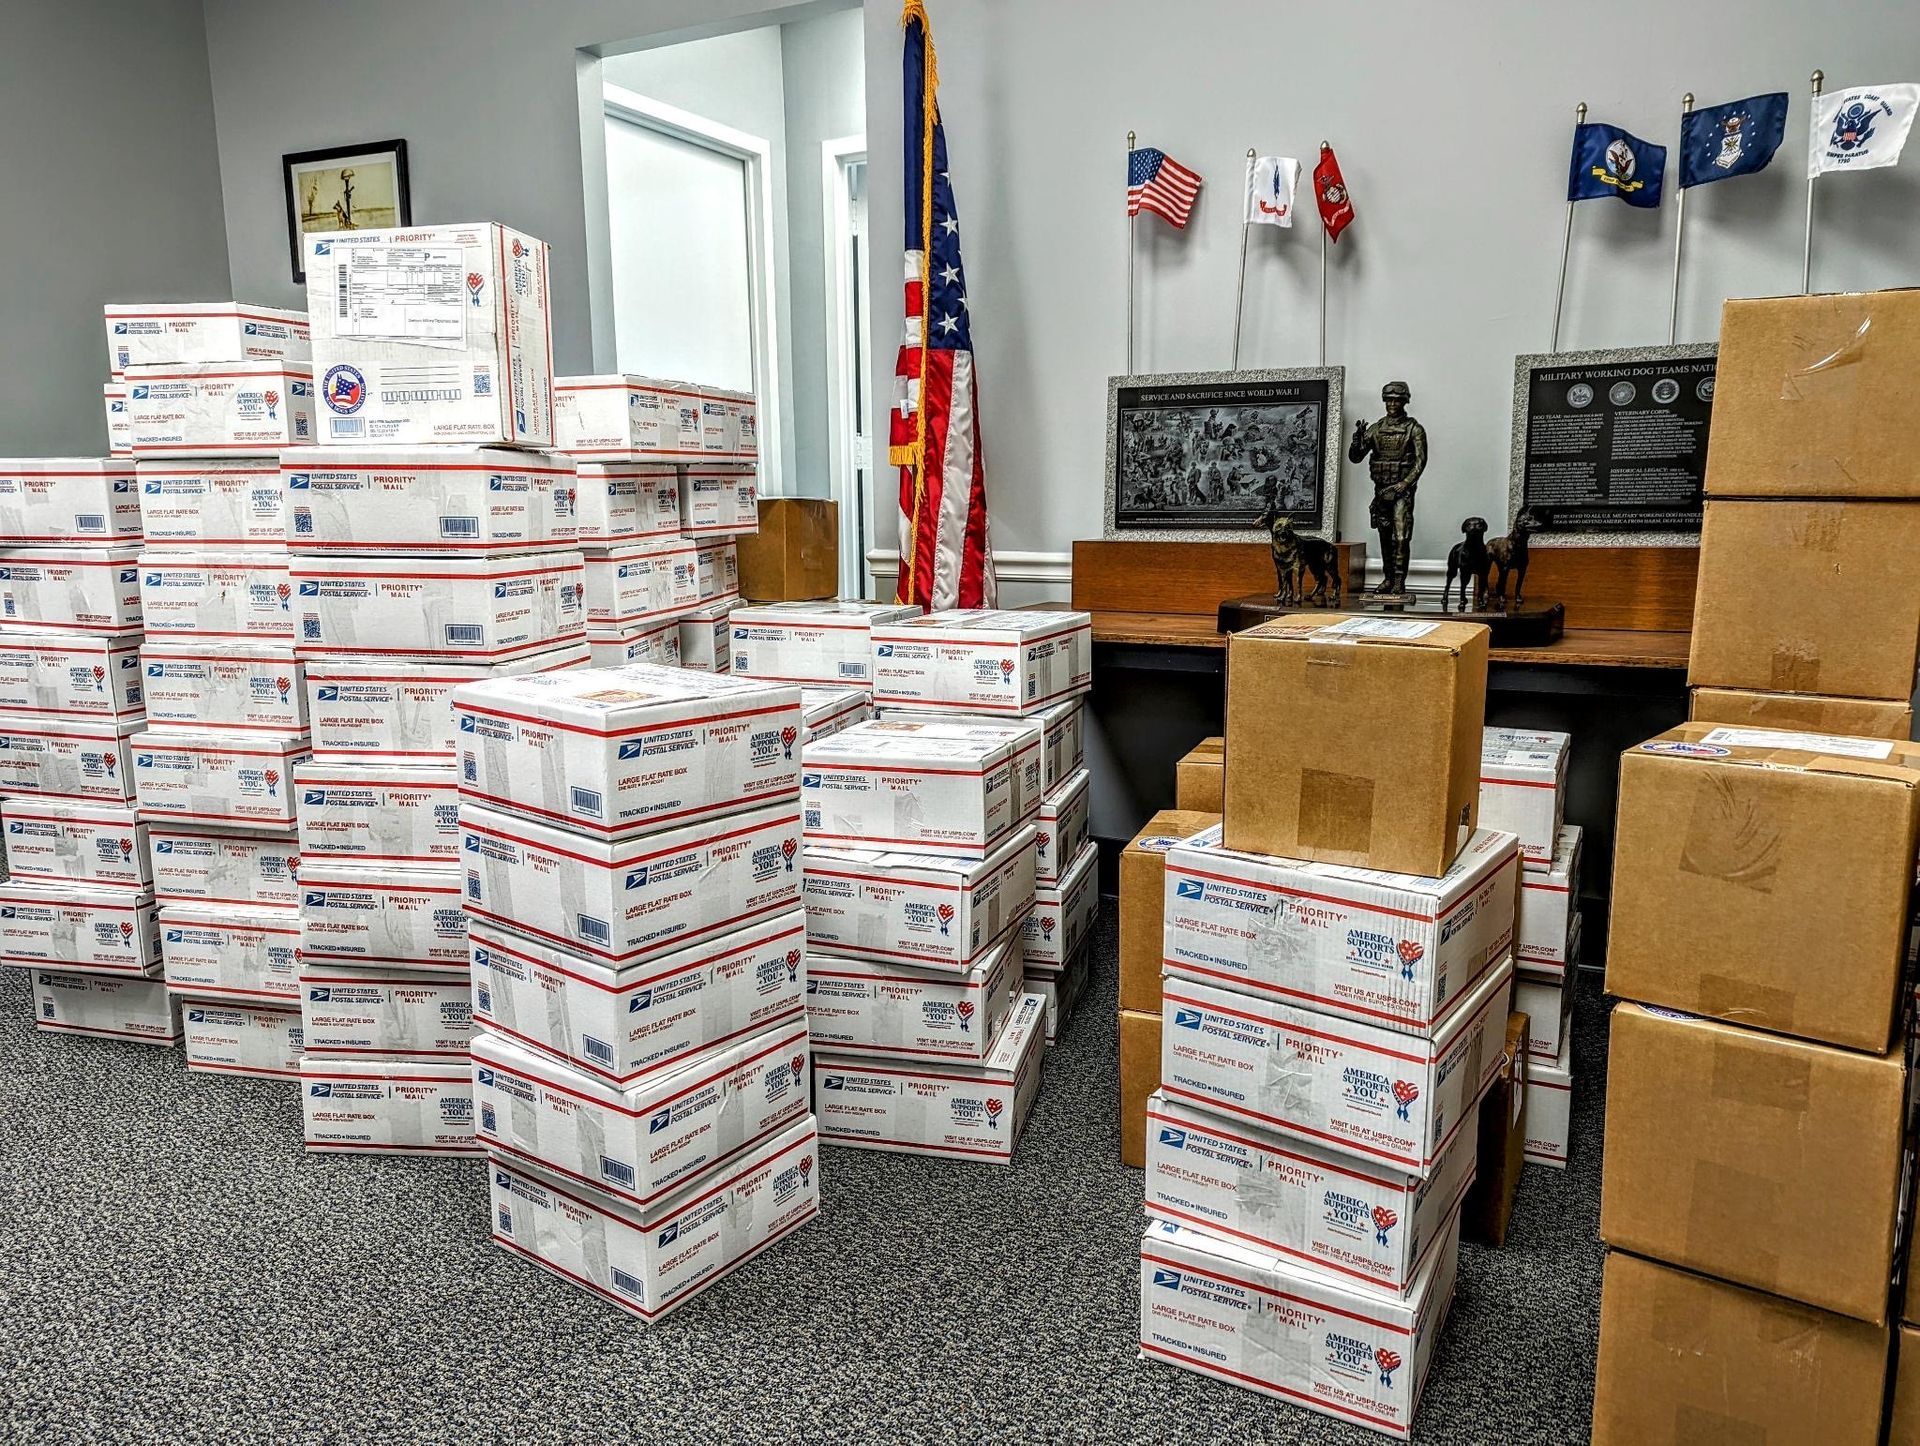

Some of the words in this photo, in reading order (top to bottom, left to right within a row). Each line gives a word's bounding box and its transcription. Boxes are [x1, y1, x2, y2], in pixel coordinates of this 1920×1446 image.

[1540, 371, 1584, 381] MILITARY
[1586, 369, 1630, 378] WORKING
[1633, 367, 1653, 376] DOG
[1657, 365, 1689, 374] TEAMS
[1186, 391, 1222, 400] SACRIFICE
[310, 482, 334, 490] POSTAL
[823, 773, 843, 782] UNITED
[845, 774, 867, 783] STATES
[752, 844, 781, 857] AMERICA
[752, 850, 782, 865] SUPPORTS
[649, 857, 674, 871] UNITED
[675, 853, 697, 866] STATES
[721, 854, 741, 863] MAIL
[758, 860, 775, 870] YOU
[648, 872, 672, 884] POSTAL
[1207, 883, 1236, 895] UNITED
[1237, 888, 1267, 901] STATES
[625, 903, 647, 915] LARGE
[648, 898, 662, 908] FLAT
[663, 894, 678, 904] RATE
[679, 890, 693, 900] BOX
[1204, 896, 1234, 907] POSTAL
[1175, 916, 1199, 928] LARGE
[1201, 922, 1217, 931] FLAT
[1220, 926, 1238, 936] RATE
[1241, 930, 1257, 940] BOX
[1300, 917, 1329, 929] MAIL
[1347, 929, 1394, 945] AMERICA
[1346, 938, 1395, 954] SUPPORTS
[1175, 948, 1209, 961] TRACKED
[1214, 957, 1248, 971] INSURED
[1357, 948, 1382, 961] YOU
[1297, 1052, 1326, 1065] MAIL
[845, 1076, 868, 1084] UNITED
[869, 1078, 892, 1086] STATES
[1343, 1067, 1390, 1085] AMERICA
[1343, 1075, 1390, 1093] SUPPORTS
[917, 1089, 937, 1098] MAIL
[1352, 1085, 1377, 1099] YOU
[950, 1097, 984, 1107] AMERICA
[950, 1104, 984, 1113] SUPPORTS
[958, 1110, 976, 1118] YOU
[1330, 1118, 1348, 1128] VISIT
[1350, 1124, 1360, 1132] US
[1184, 1274, 1214, 1290] UNITED
[1216, 1282, 1245, 1298] STATES
[1181, 1286, 1211, 1302] POSTAL
[1151, 1303, 1177, 1316] LARGE
[1178, 1309, 1196, 1320] FLAT
[1197, 1314, 1217, 1325] RATE
[1219, 1321, 1236, 1333] BOX
[1279, 1316, 1308, 1330] MAIL
[1152, 1333, 1188, 1349] TRACKED
[1192, 1345, 1227, 1361] INSURED
